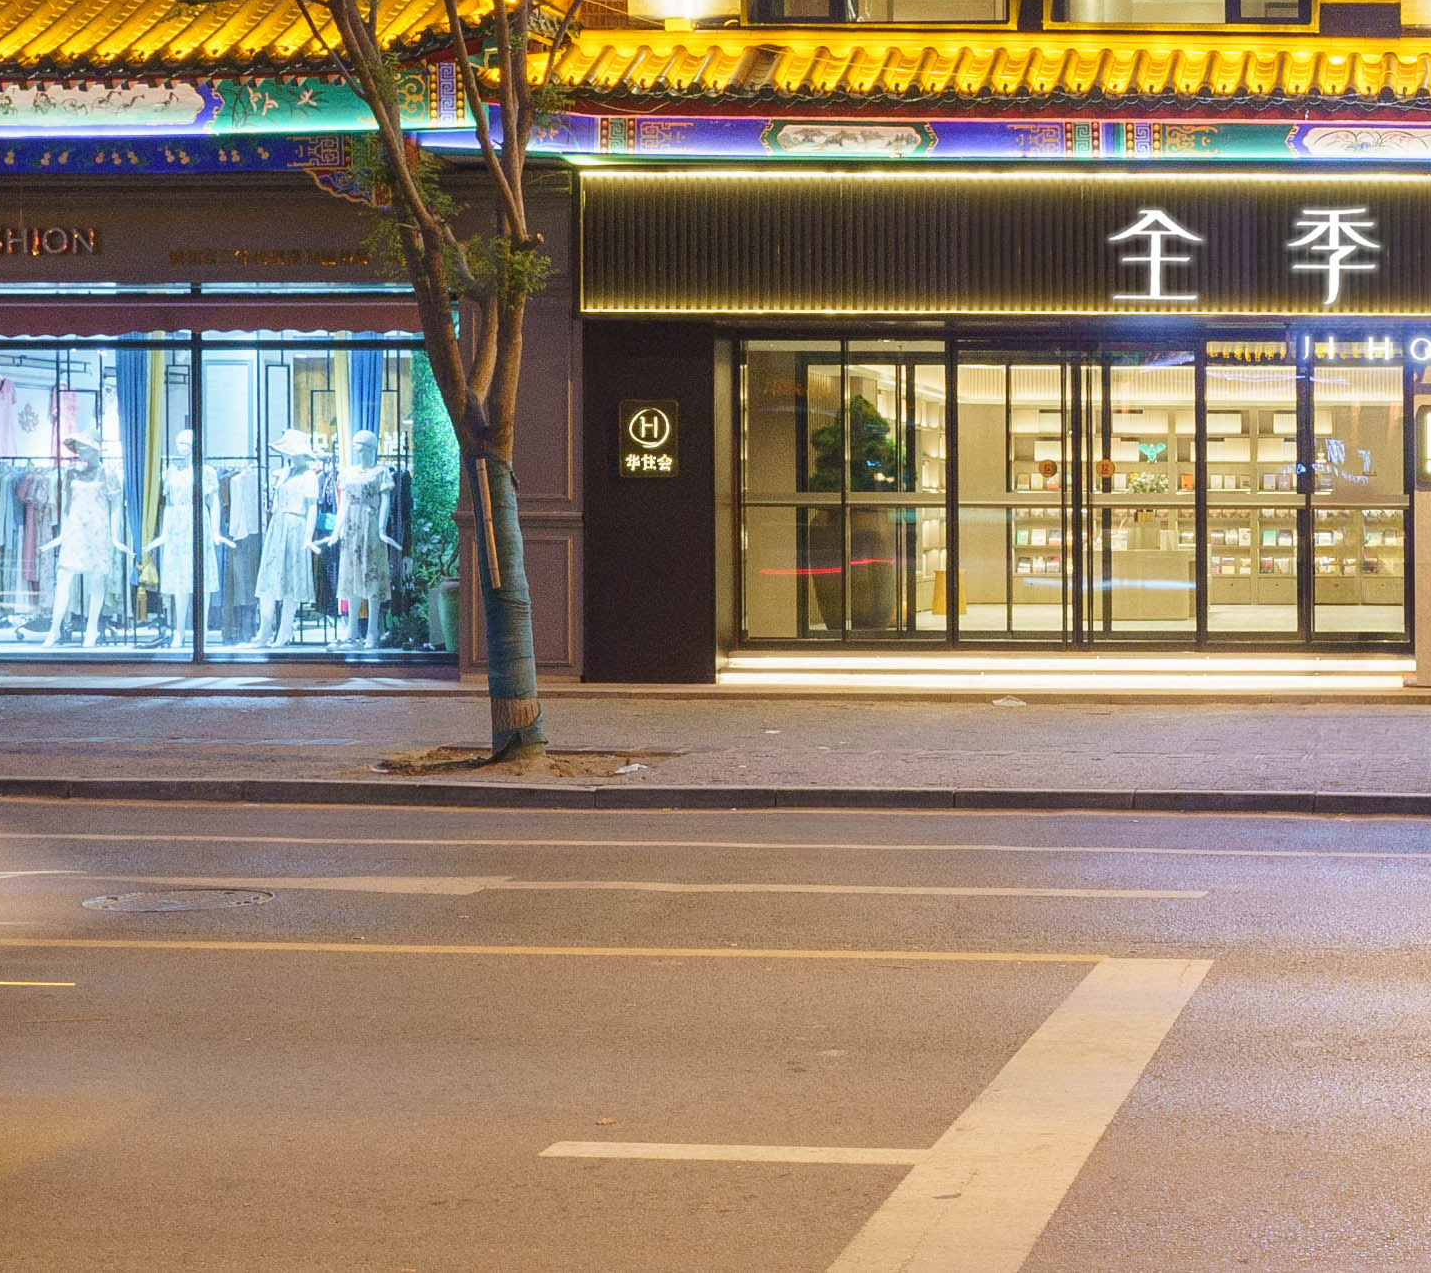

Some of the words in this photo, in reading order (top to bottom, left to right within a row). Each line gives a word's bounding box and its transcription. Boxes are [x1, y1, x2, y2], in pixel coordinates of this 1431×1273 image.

[1303, 335, 1334, 360] JI
[625, 454, 673, 472] 华住会
